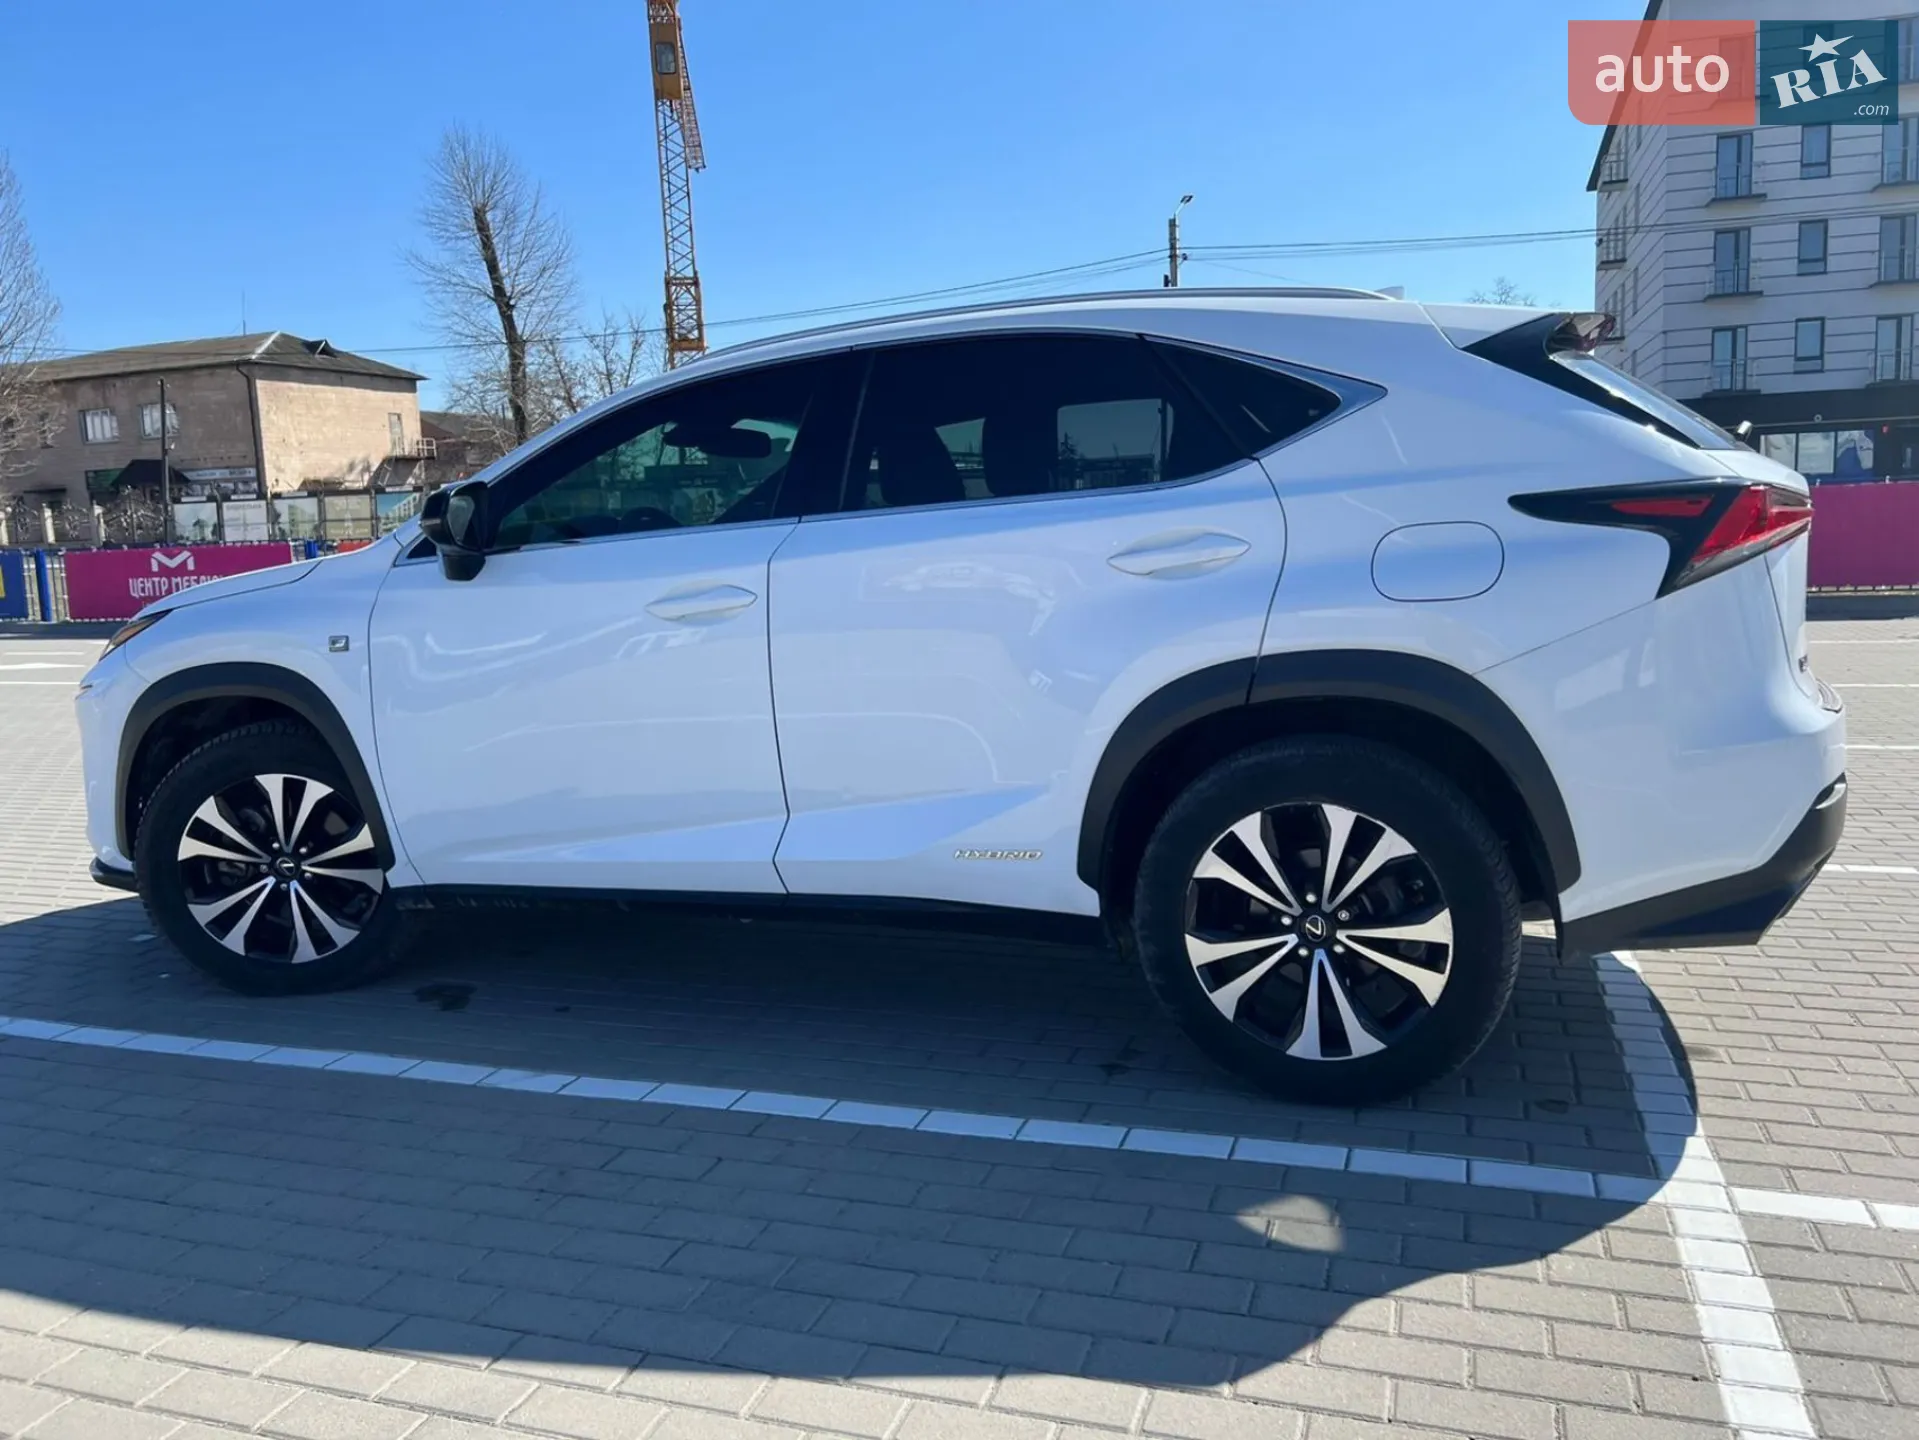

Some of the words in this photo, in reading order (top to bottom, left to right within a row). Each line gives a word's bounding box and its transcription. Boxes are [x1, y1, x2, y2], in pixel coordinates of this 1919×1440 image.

[128, 577, 169, 598] ЦЕНТР
[171, 574, 220, 594] МЕБ
[953, 849, 1043, 861] HYBRID
